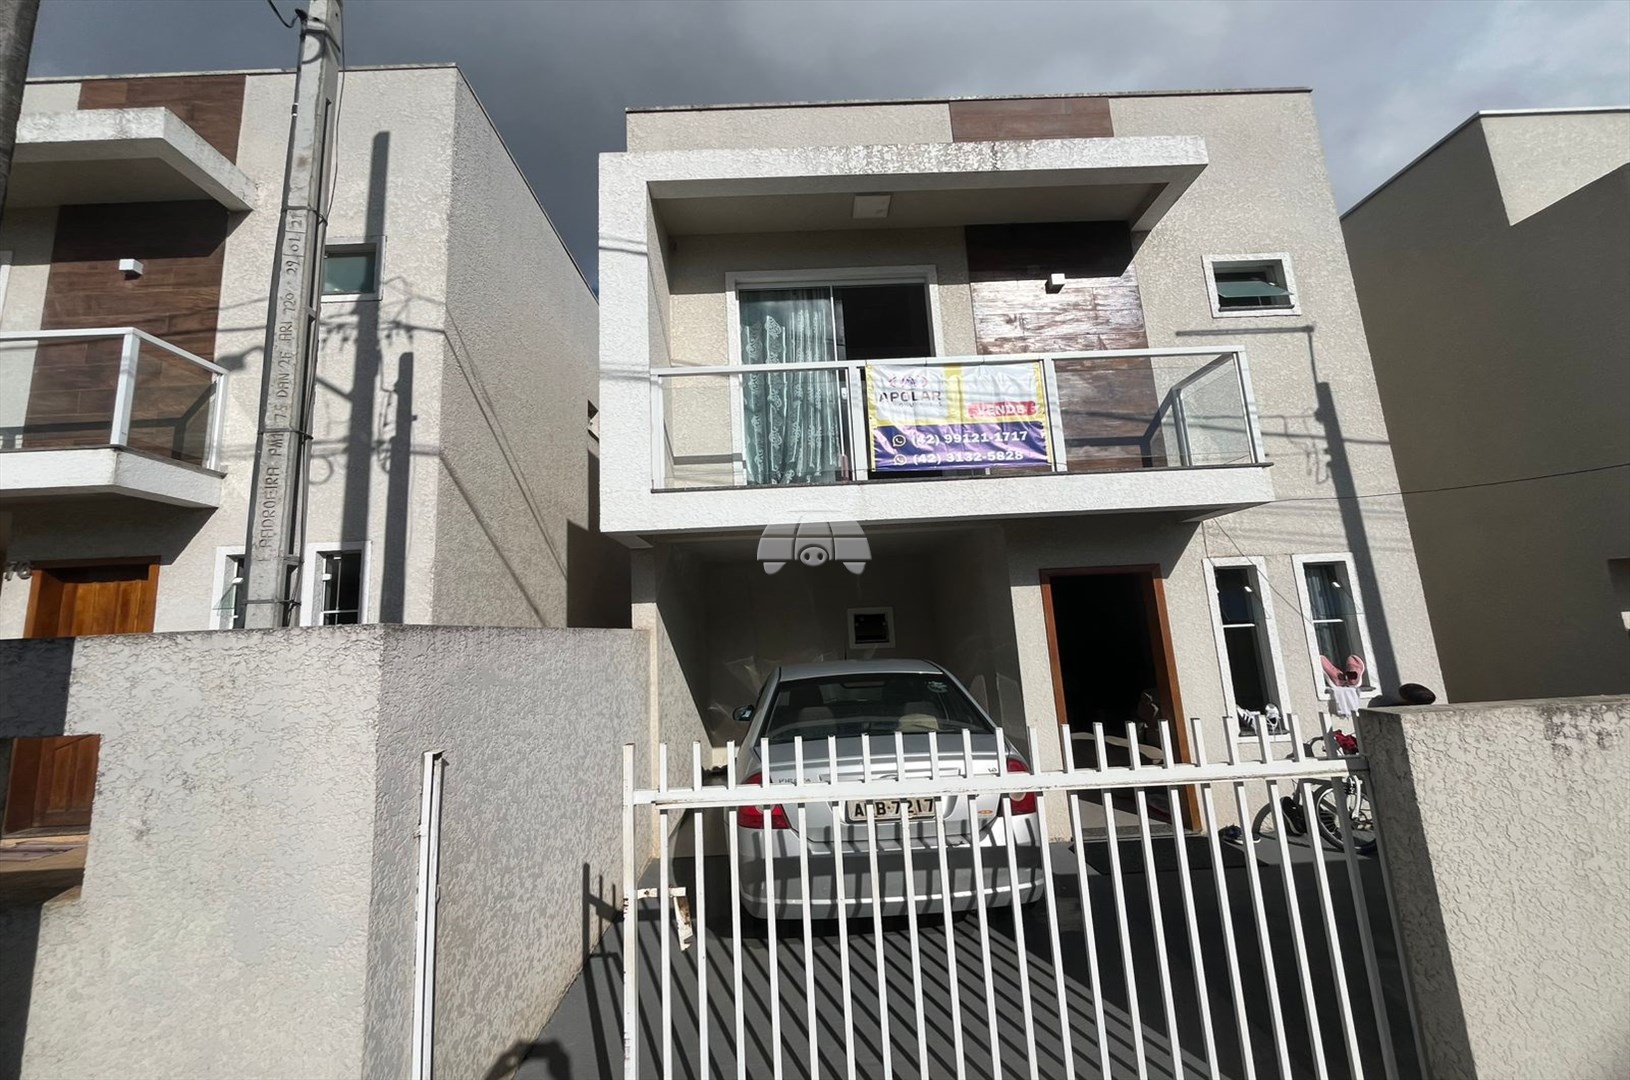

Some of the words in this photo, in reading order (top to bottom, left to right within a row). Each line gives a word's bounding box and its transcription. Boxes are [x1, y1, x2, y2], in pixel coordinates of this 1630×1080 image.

[880, 391, 942, 402] APOLAR
[944, 431, 1028, 443] 99121-1717
[913, 453, 941, 466] (42)
[946, 451, 1024, 463] 3132-5828
